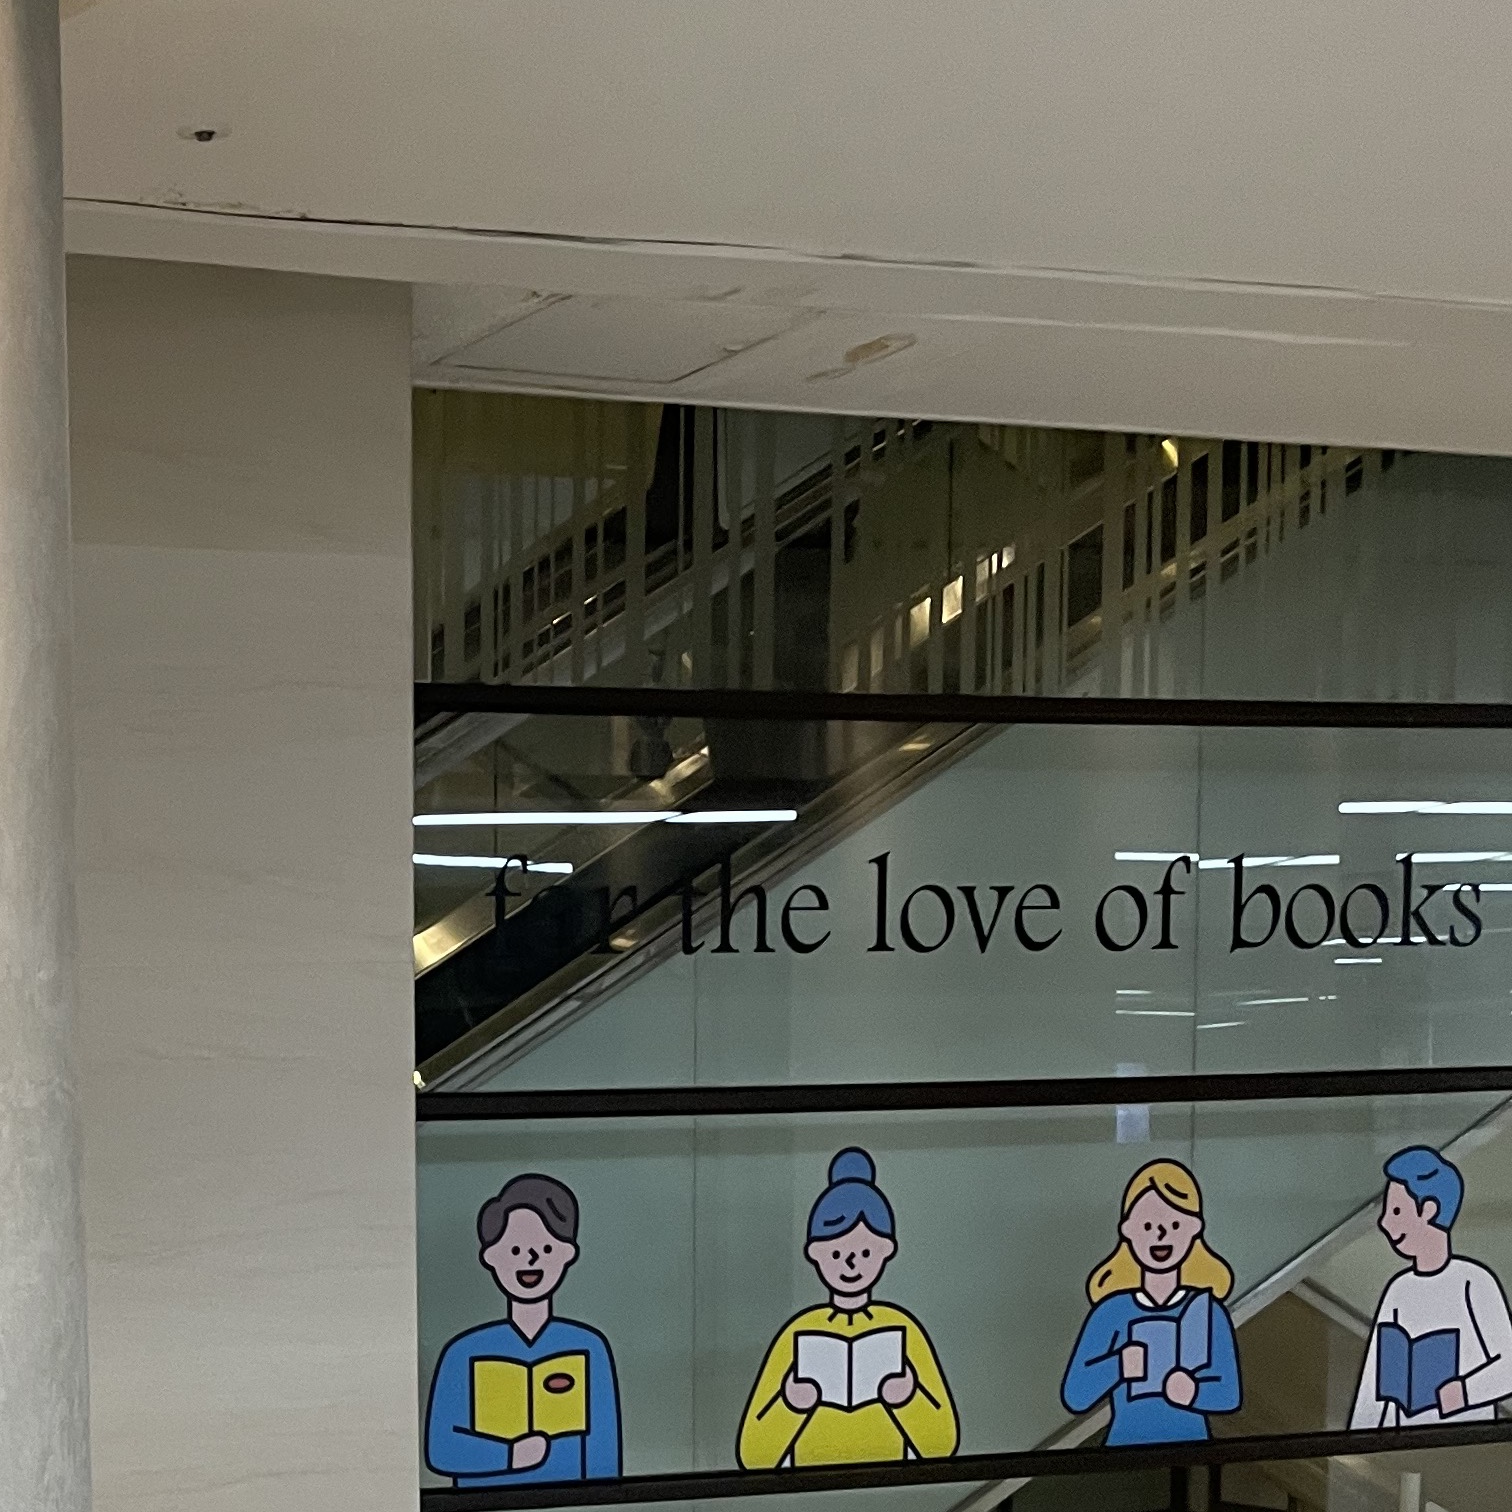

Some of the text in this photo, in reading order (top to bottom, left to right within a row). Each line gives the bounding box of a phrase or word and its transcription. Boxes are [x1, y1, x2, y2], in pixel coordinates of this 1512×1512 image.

[681, 851, 832, 954] the
[866, 850, 1062, 953] love
[1095, 855, 1192, 952] of
[1225, 852, 1483, 954] books
